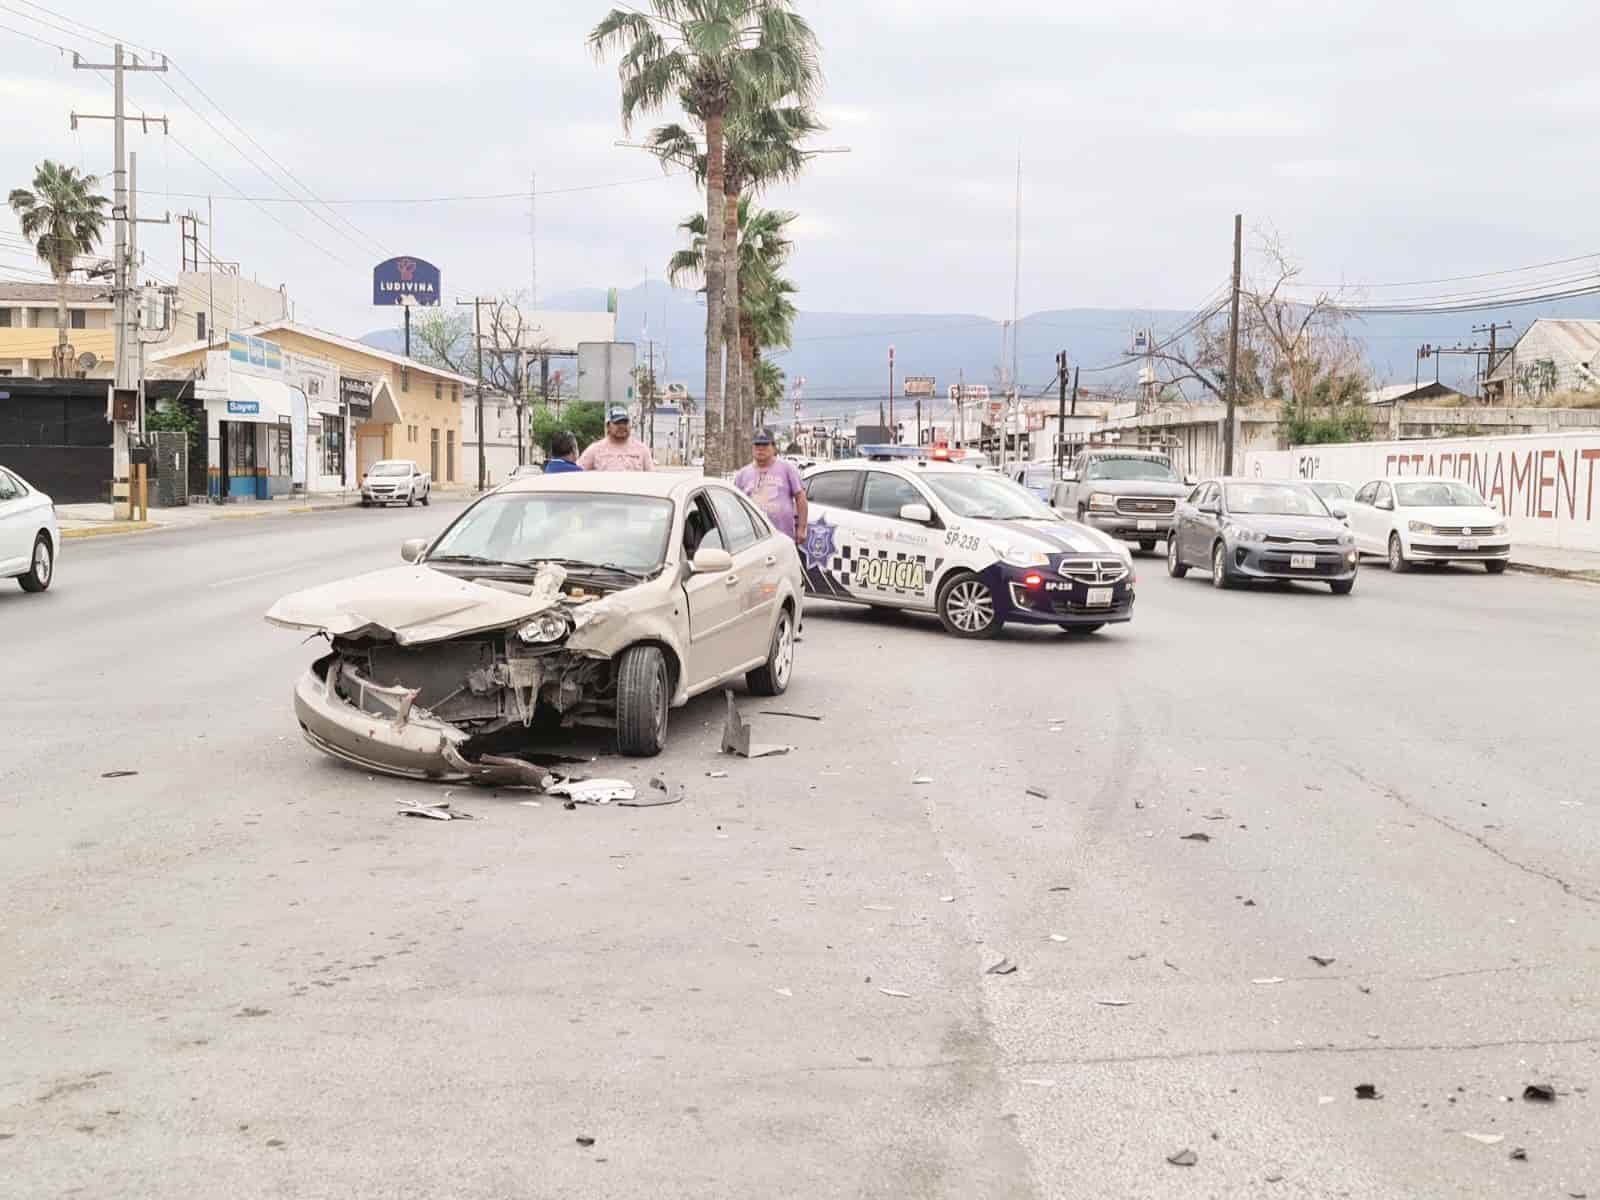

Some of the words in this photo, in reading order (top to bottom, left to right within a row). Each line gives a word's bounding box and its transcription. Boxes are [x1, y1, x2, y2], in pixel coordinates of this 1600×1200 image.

[380, 281, 434, 293] LUDIVINA
[944, 531, 981, 552] SP-238
[855, 556, 925, 591] POLICÍA
